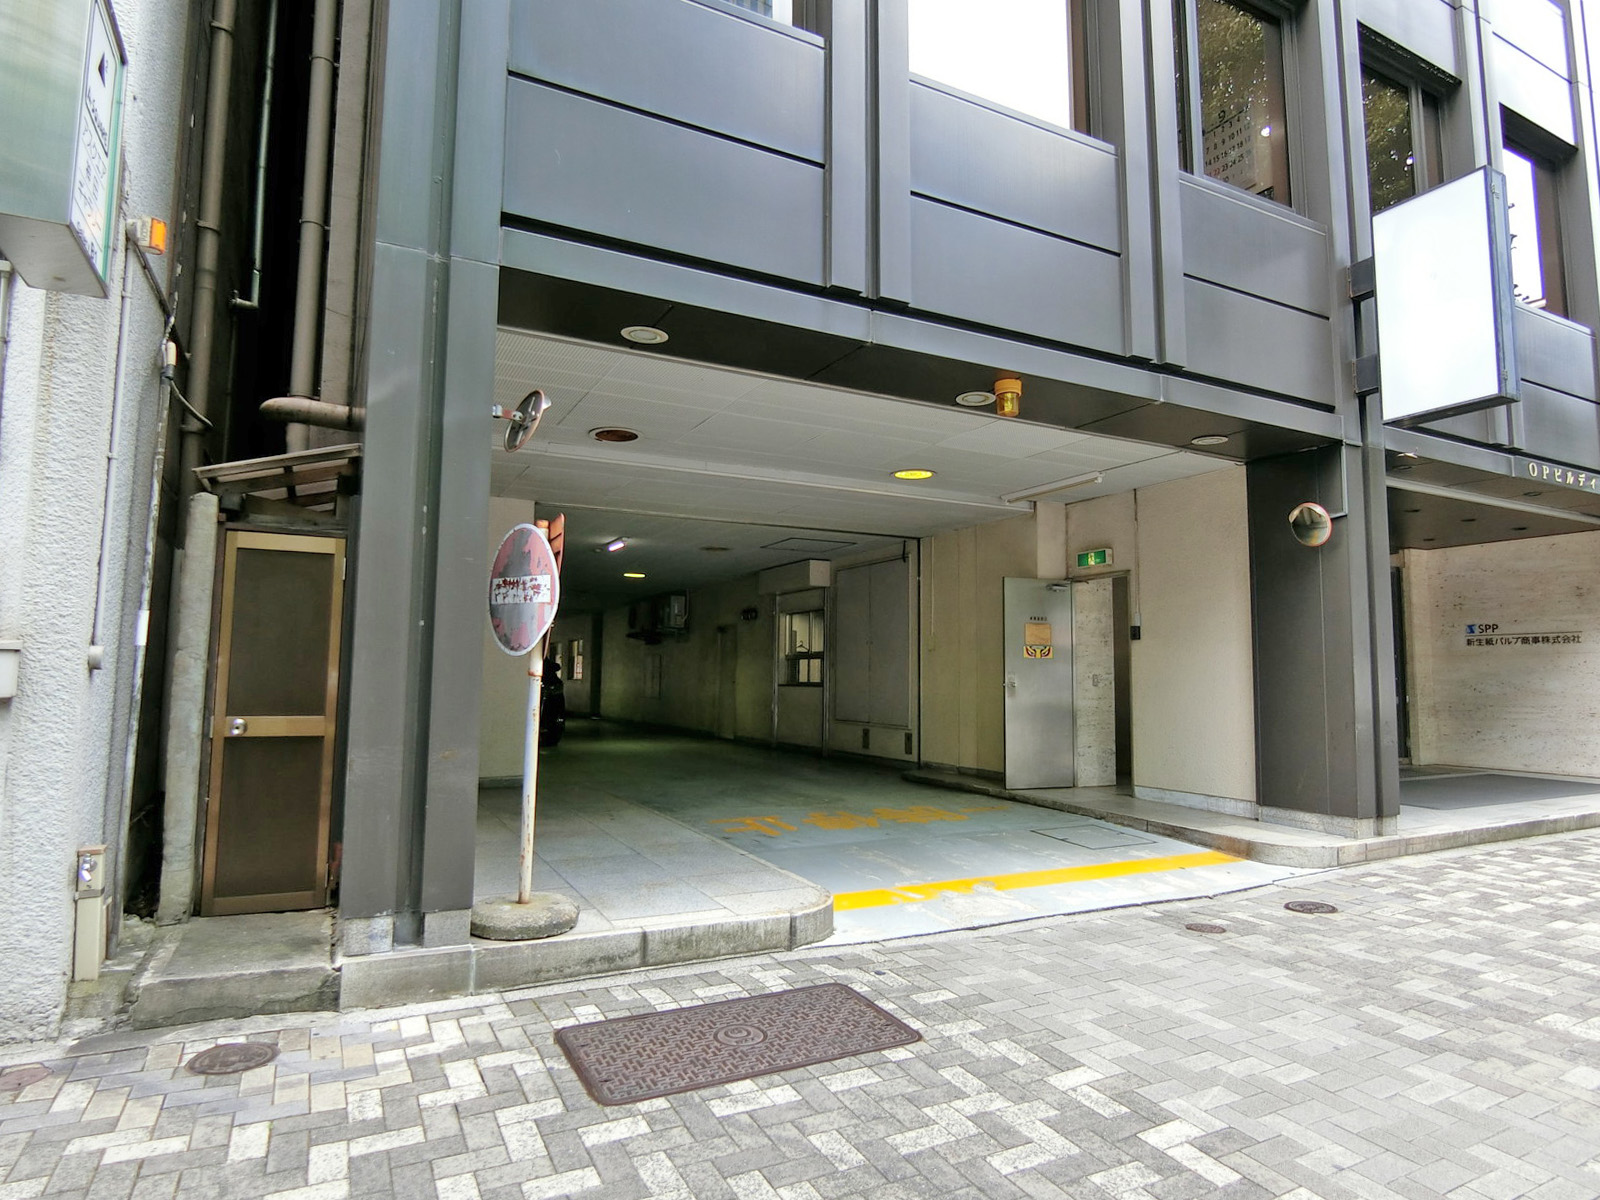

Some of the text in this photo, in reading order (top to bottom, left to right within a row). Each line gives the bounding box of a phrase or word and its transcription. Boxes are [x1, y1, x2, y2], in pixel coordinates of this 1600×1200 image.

[1218, 110, 1225, 123] 9
[1229, 132, 1235, 141] 10
[1236, 127, 1242, 136] 11
[1213, 155, 1219, 163] 15
[1222, 163, 1228, 172] 23
[1237, 153, 1244, 163] 25
[1478, 624, 1499, 634] SPP
[1466, 635, 1582, 647] 新生紙パルプ商事株式会社
